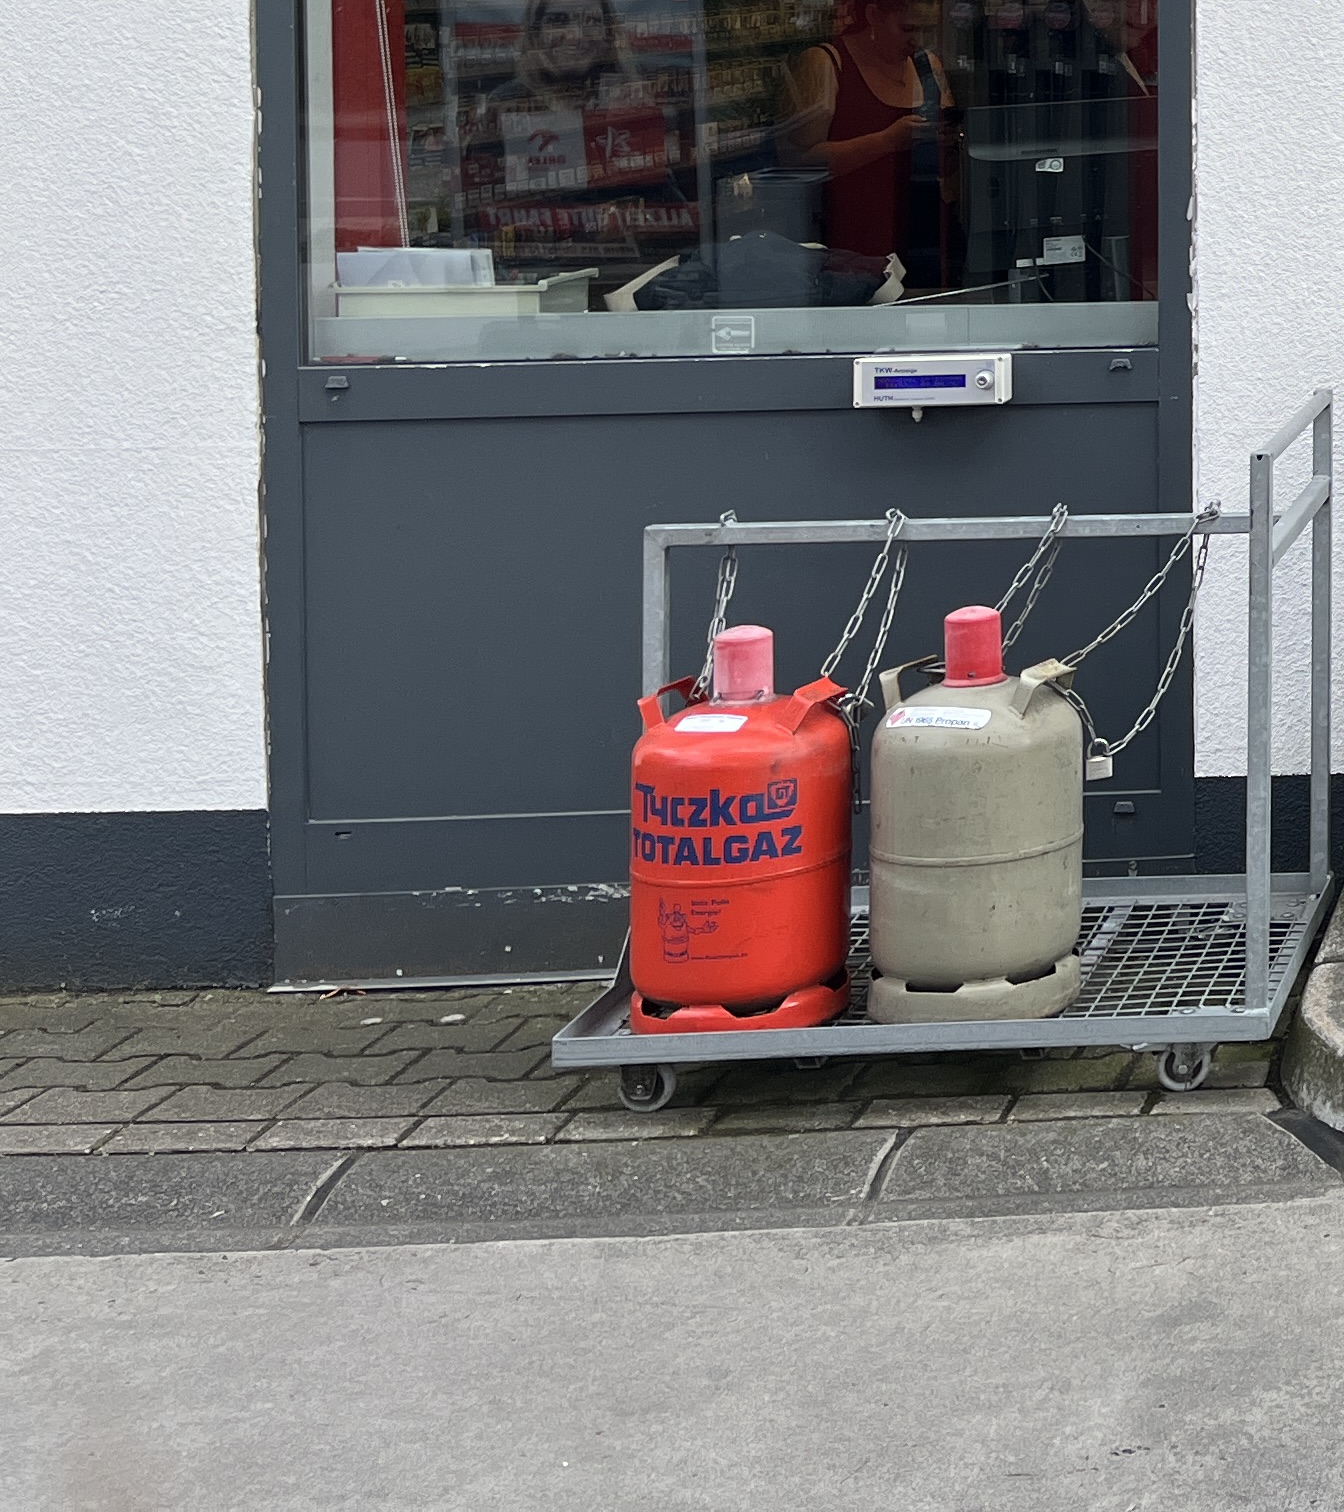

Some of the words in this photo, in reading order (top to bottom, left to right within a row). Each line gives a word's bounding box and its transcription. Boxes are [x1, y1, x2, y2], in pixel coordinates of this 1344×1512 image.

[935, 717, 970, 726] Propan
[635, 781, 796, 828] Tyczka
[633, 825, 802, 866] TOTALGAZ
